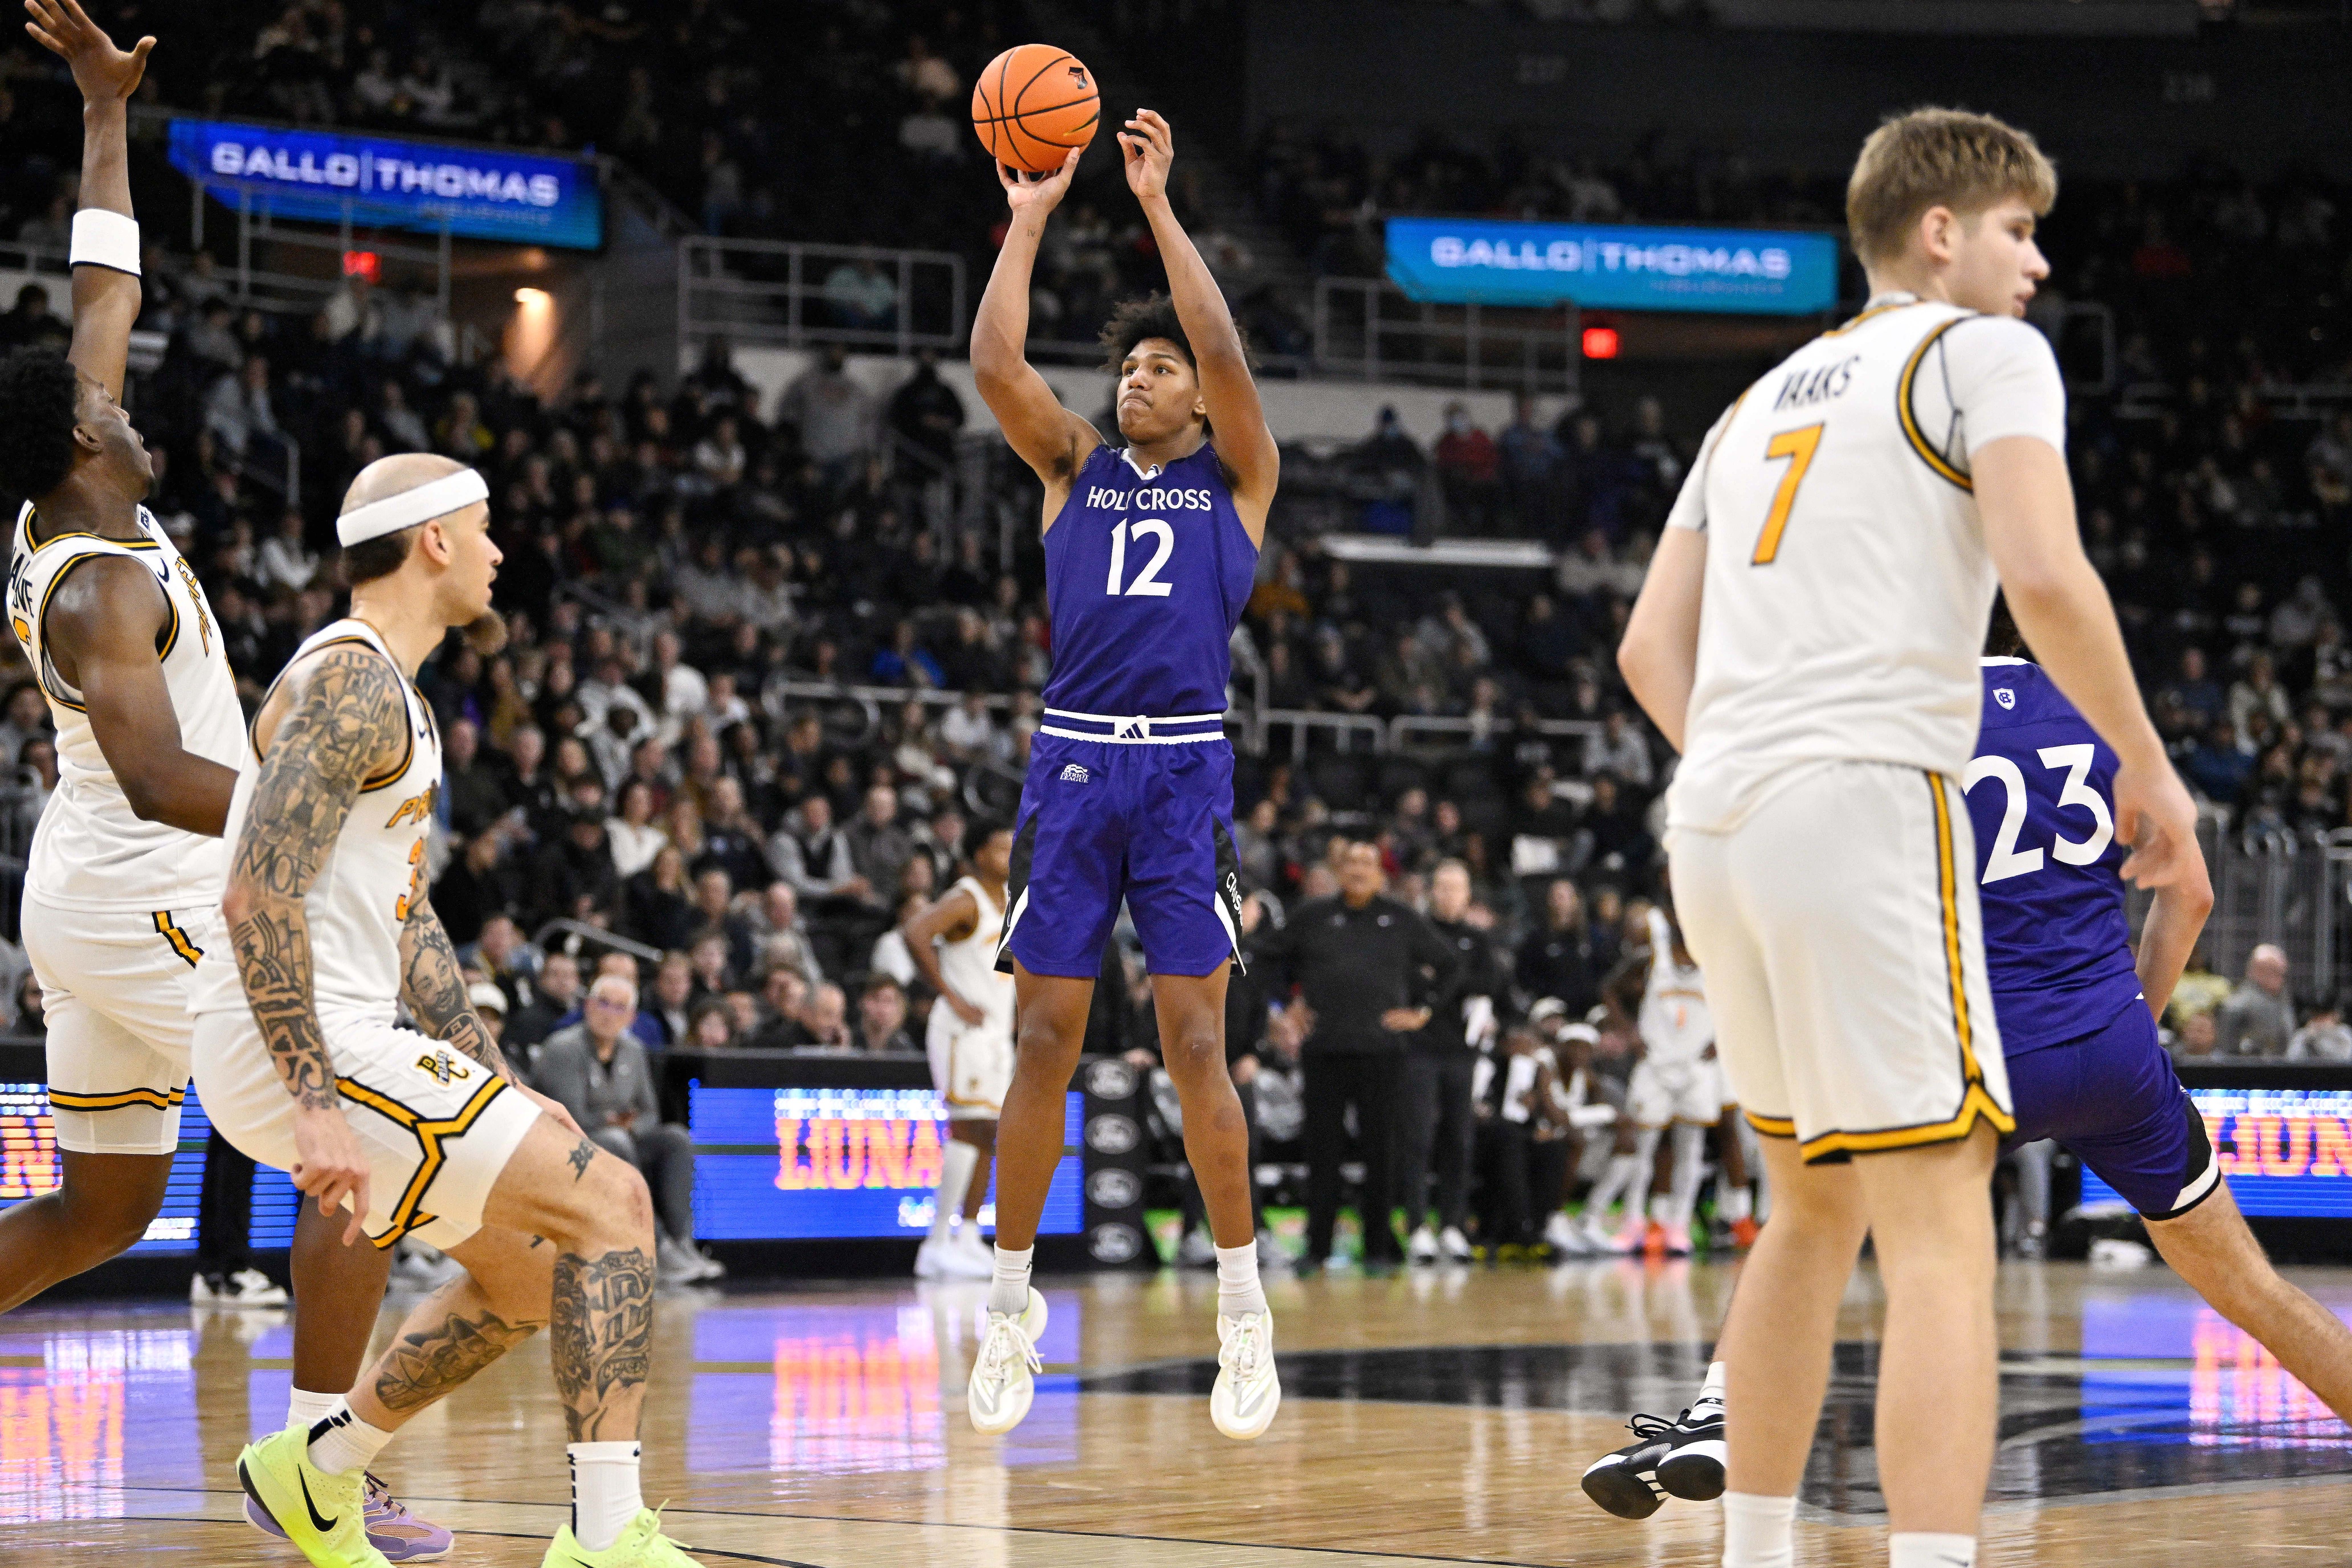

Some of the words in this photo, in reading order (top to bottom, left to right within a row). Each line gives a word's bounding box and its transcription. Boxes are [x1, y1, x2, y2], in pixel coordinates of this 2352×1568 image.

[1136, 488, 1211, 511] CROSS
[1750, 420, 1827, 567] 7
[1106, 517, 1174, 597] 12
[1961, 744, 2114, 884] 23
